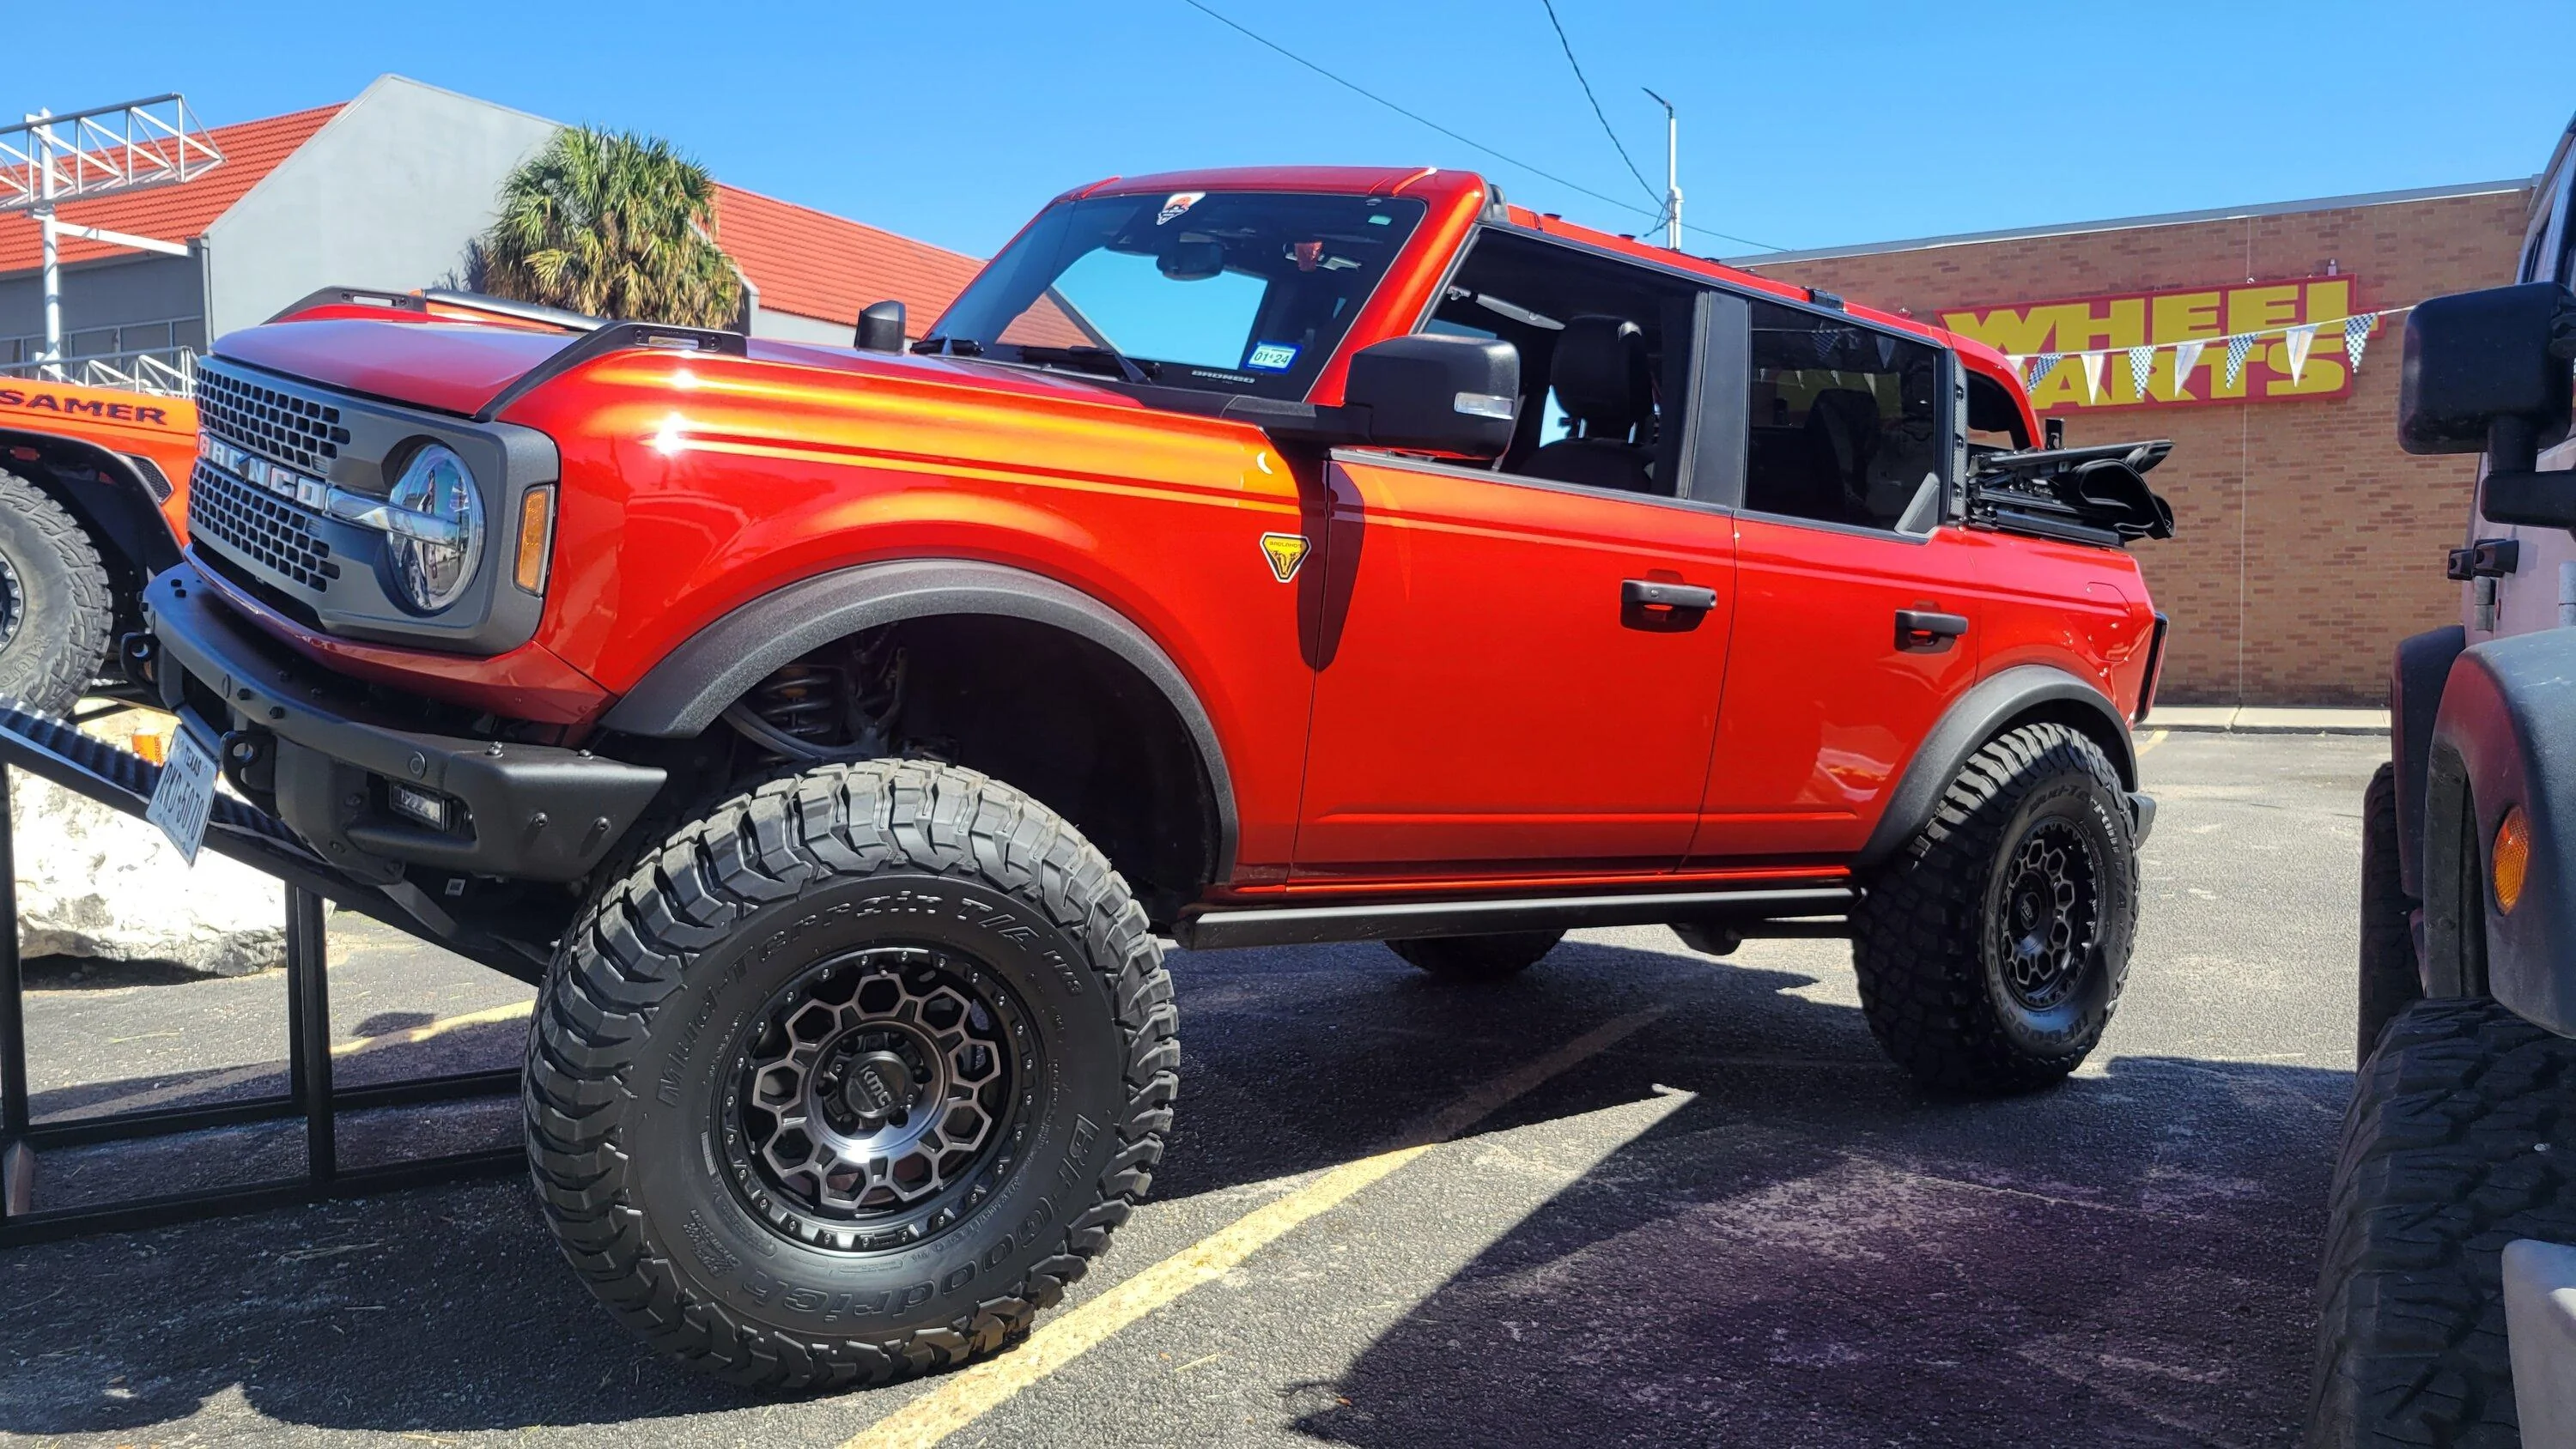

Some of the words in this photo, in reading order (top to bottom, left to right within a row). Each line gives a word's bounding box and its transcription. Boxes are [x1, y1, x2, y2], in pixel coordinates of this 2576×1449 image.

[1942, 280, 2379, 355] WHEEL
[2020, 337, 2345, 409] ARTS
[184, 744, 203, 778] TEXAS
